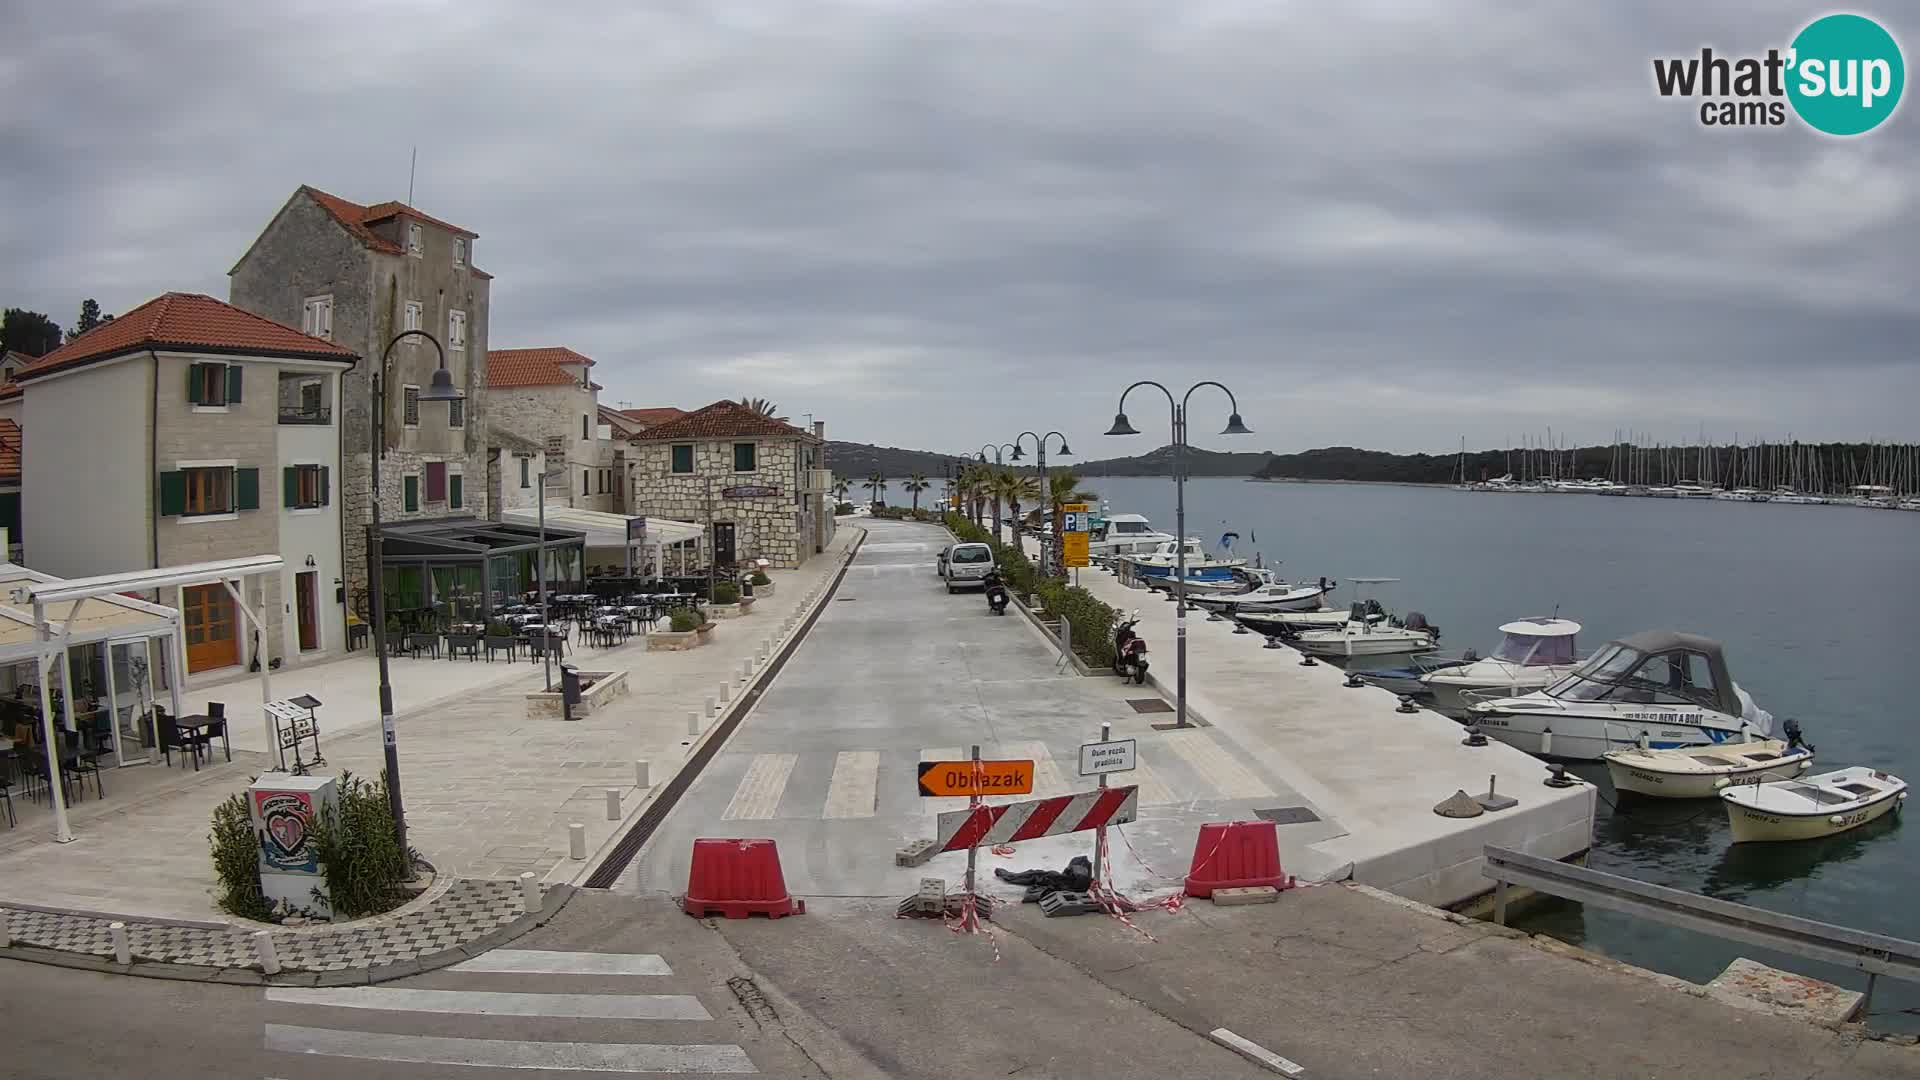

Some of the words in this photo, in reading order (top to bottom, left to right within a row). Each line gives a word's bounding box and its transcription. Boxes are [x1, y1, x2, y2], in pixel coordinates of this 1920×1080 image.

[1658, 713, 1678, 722] RENT
[1678, 713, 1685, 722] A
[1685, 713, 1704, 725] BOAT
[946, 771, 1024, 788] Obilazak
